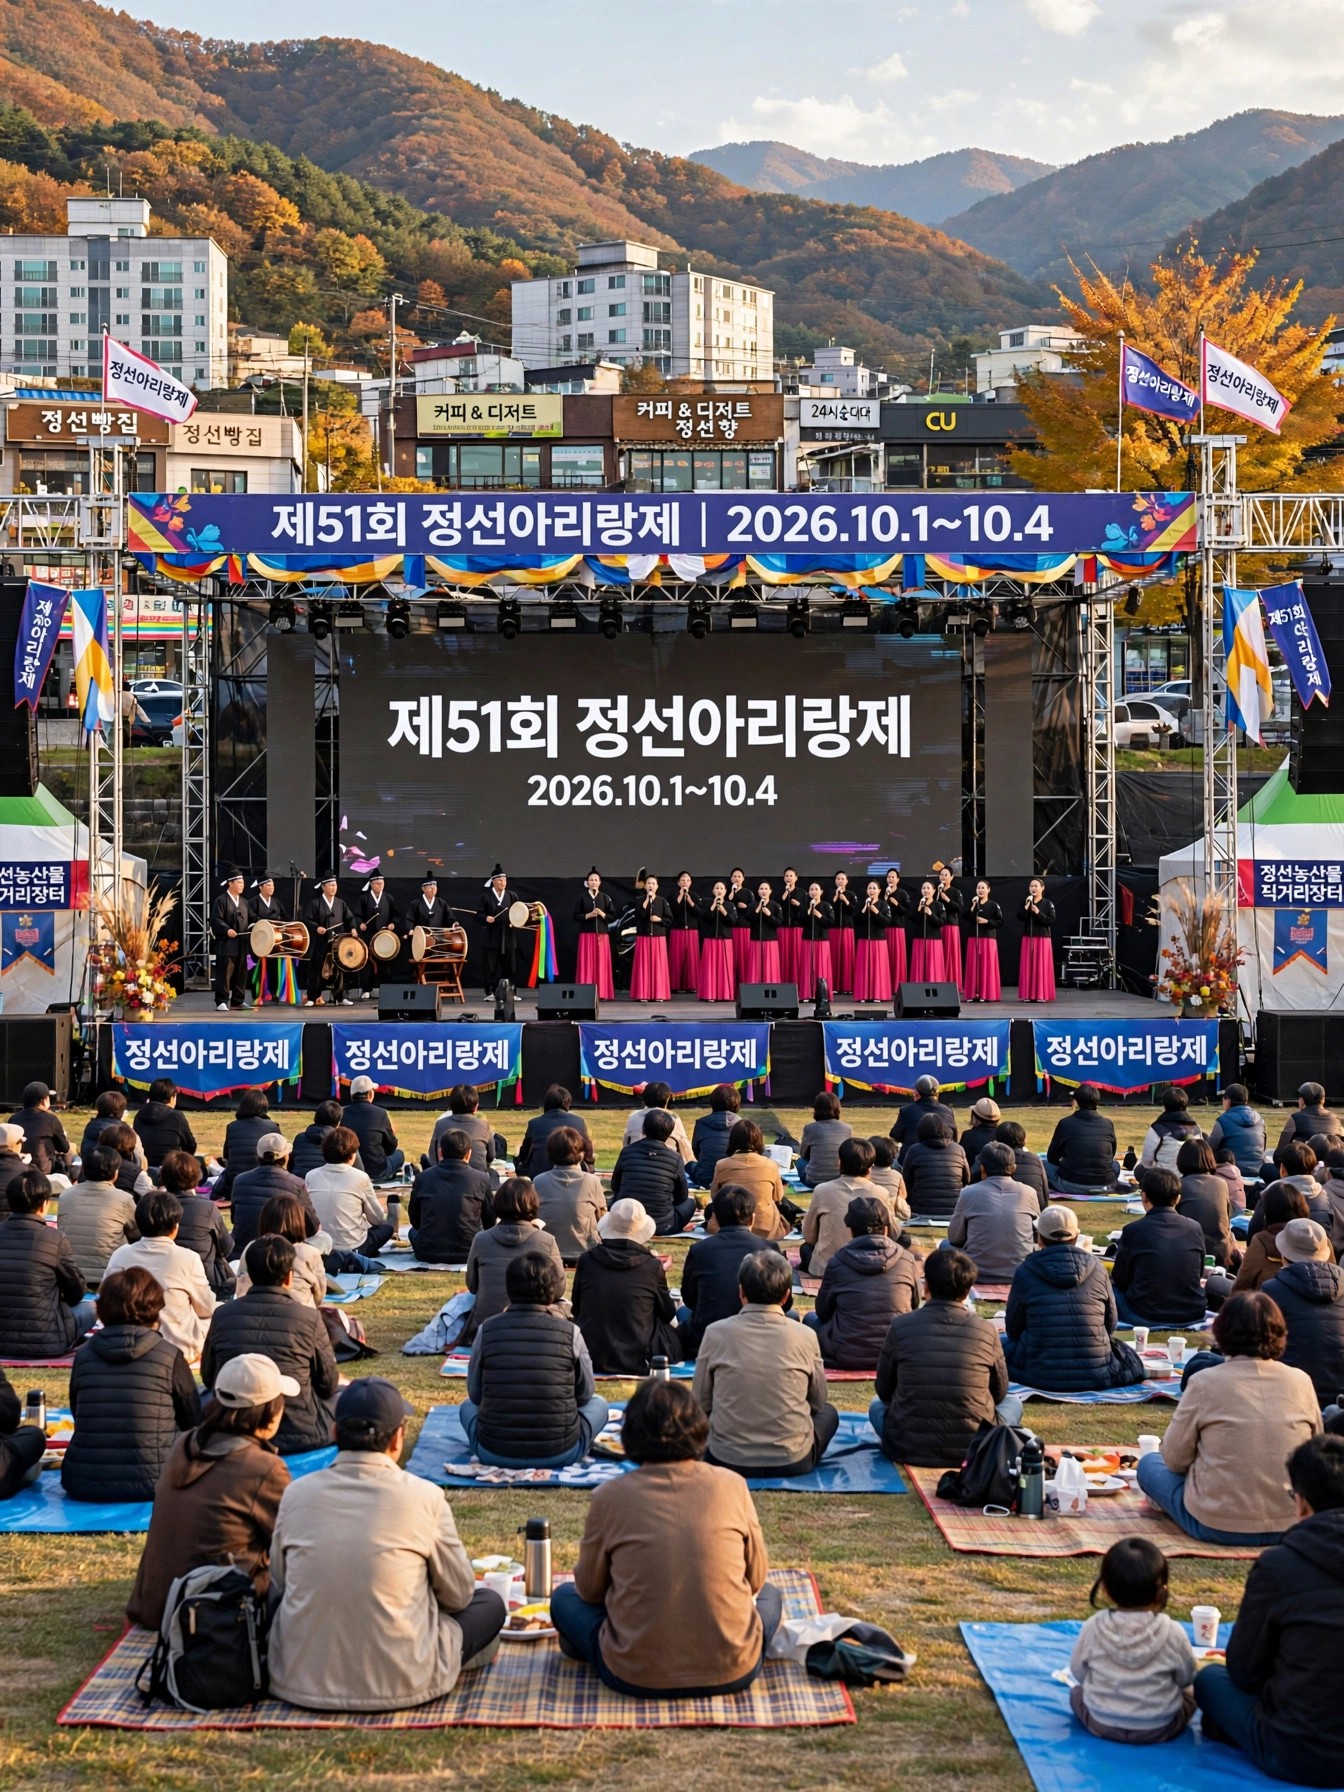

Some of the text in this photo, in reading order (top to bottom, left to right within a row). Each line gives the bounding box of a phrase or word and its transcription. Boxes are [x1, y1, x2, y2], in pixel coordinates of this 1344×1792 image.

[109, 360, 189, 408] 정선아리랑제
[1126, 365, 1195, 408] 정선아리랑제
[1206, 363, 1280, 415] 정선아리랑제
[41, 409, 138, 435] 정선빵집
[434, 403, 537, 422] 커피 & 디저트
[637, 401, 752, 420] 커피 & 디저트
[925, 411, 957, 431] CU
[183, 424, 262, 447] 정선빵집
[676, 419, 739, 440] 정선향
[271, 501, 406, 548] 제51회
[420, 500, 680, 548] 정선아리랑제
[726, 504, 1054, 543] 2026.10.1~10.4
[1267, 602, 1306, 626] 제51회
[387, 694, 911, 759] 제51회 정선아리랑제
[527, 774, 778, 807] 2026.10.1~10.4
[1260, 884, 1343, 903] 직거리장터
[125, 1038, 290, 1071] 정선아리랑제
[345, 1038, 509, 1071] 정선아리랑제
[593, 1037, 757, 1070] 정선아리랑제
[836, 1035, 999, 1068] 정선아리랑제
[1046, 1034, 1207, 1066] 정선아리랑제
